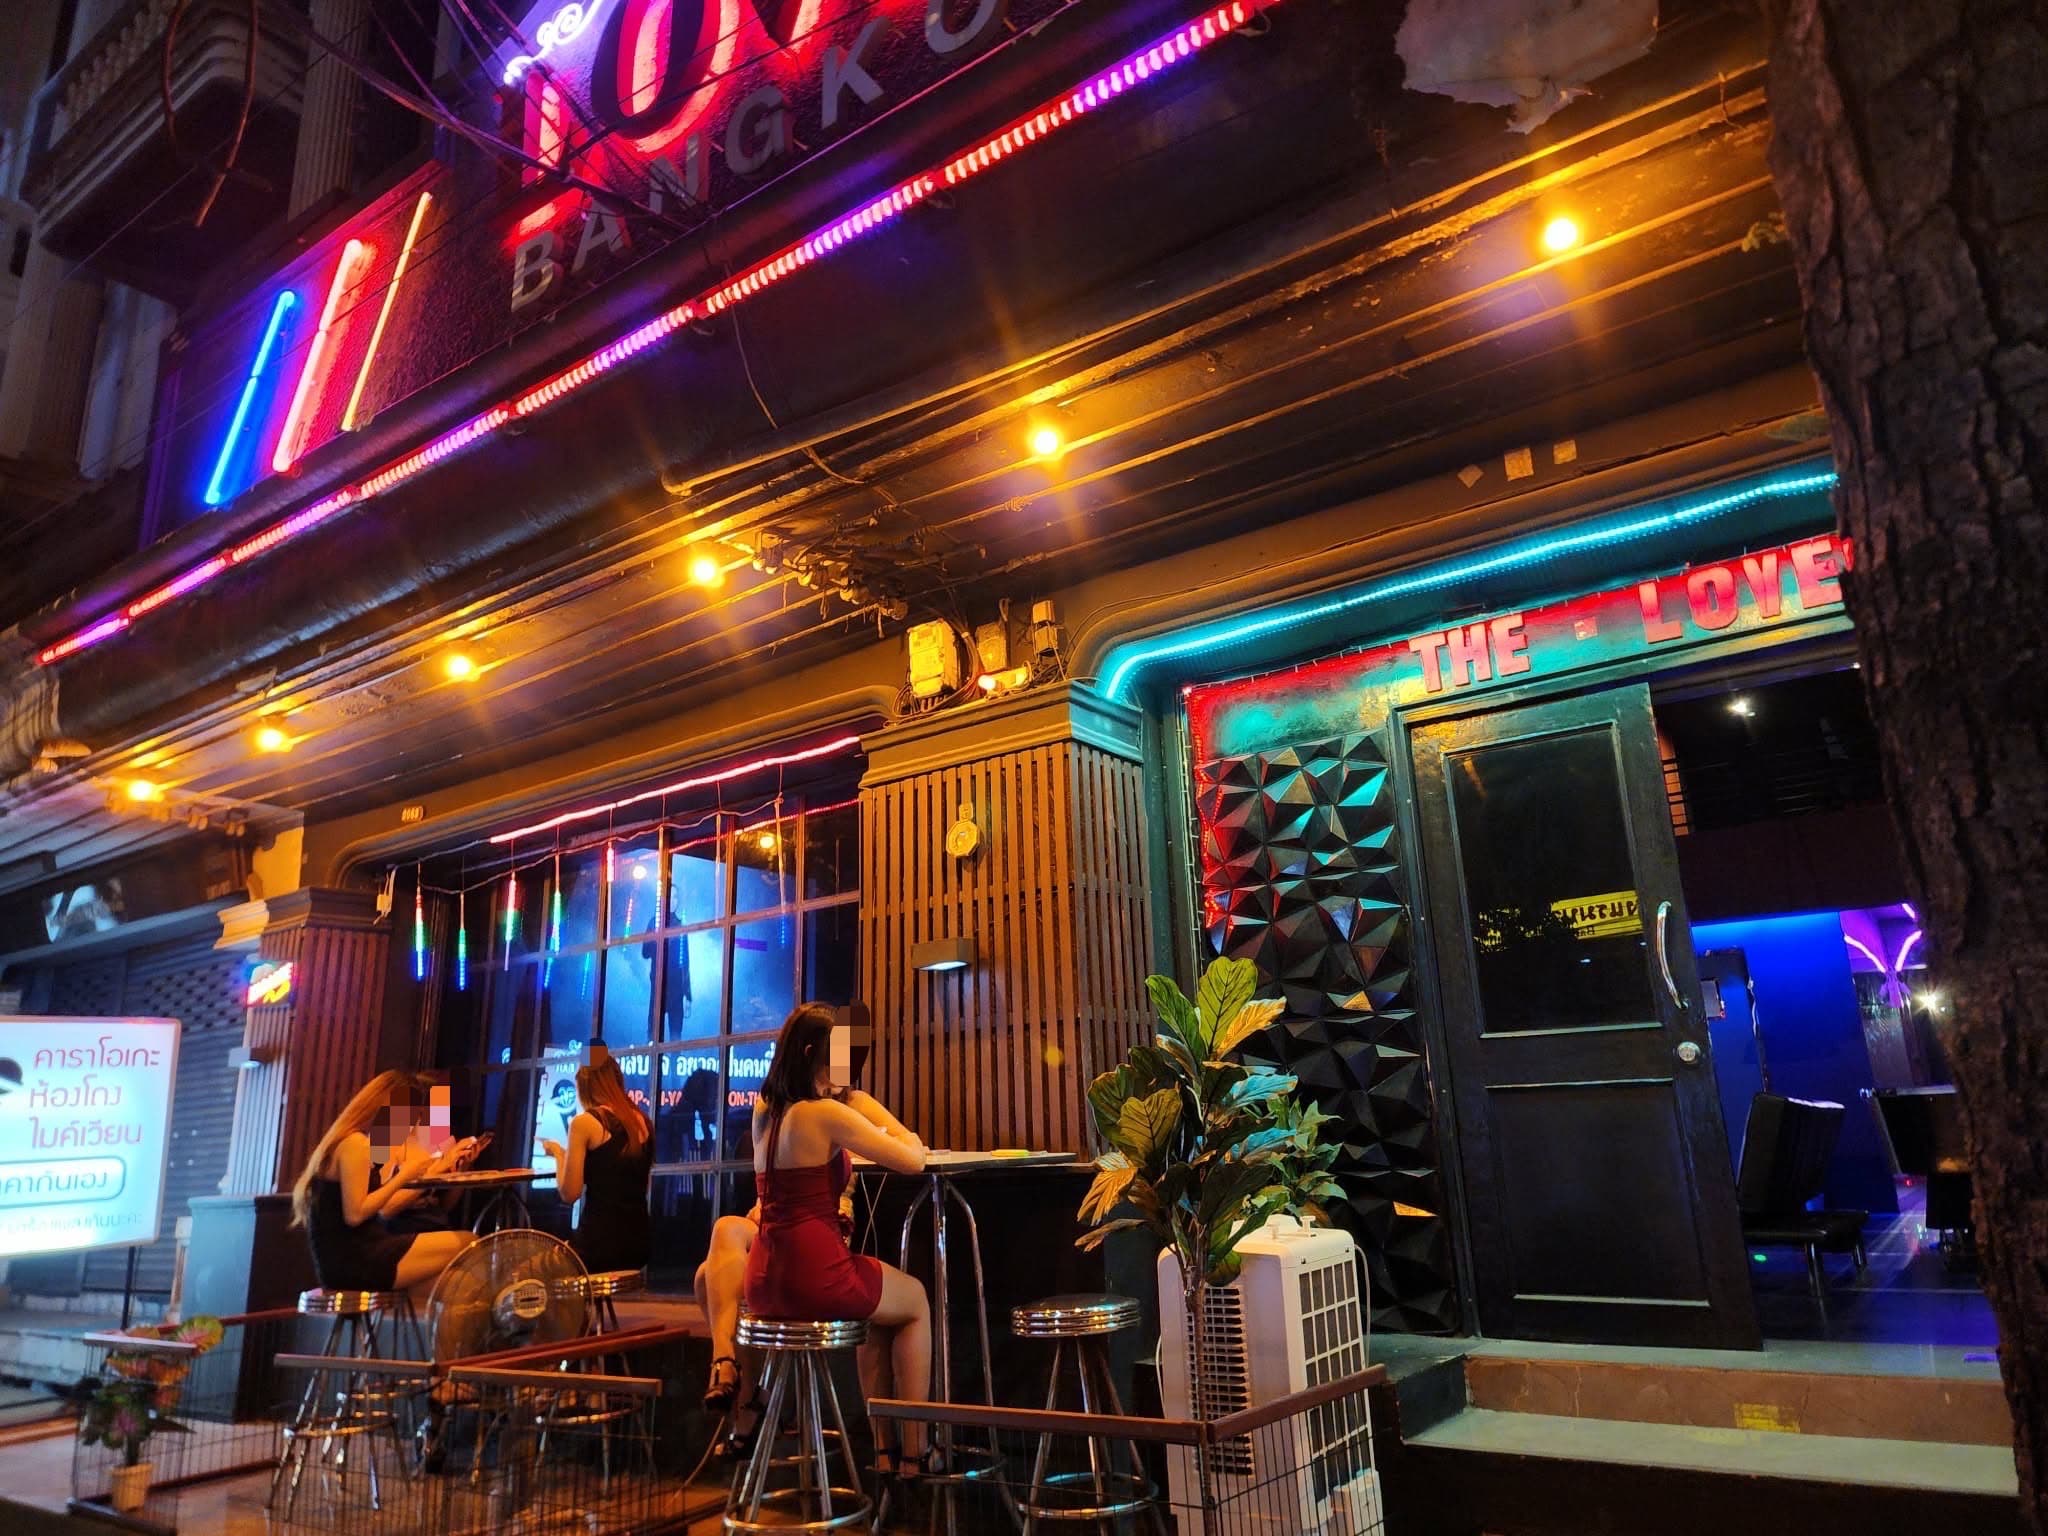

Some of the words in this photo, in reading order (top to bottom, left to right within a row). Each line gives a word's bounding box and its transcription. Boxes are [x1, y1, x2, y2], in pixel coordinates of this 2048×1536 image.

[1408, 614, 1531, 693] THE
[33, 1035, 161, 1069] คาราโอเกะ
[28, 1116, 142, 1150] ไมค์เวียน
[0, 1169, 108, 1194] คากันเอง
